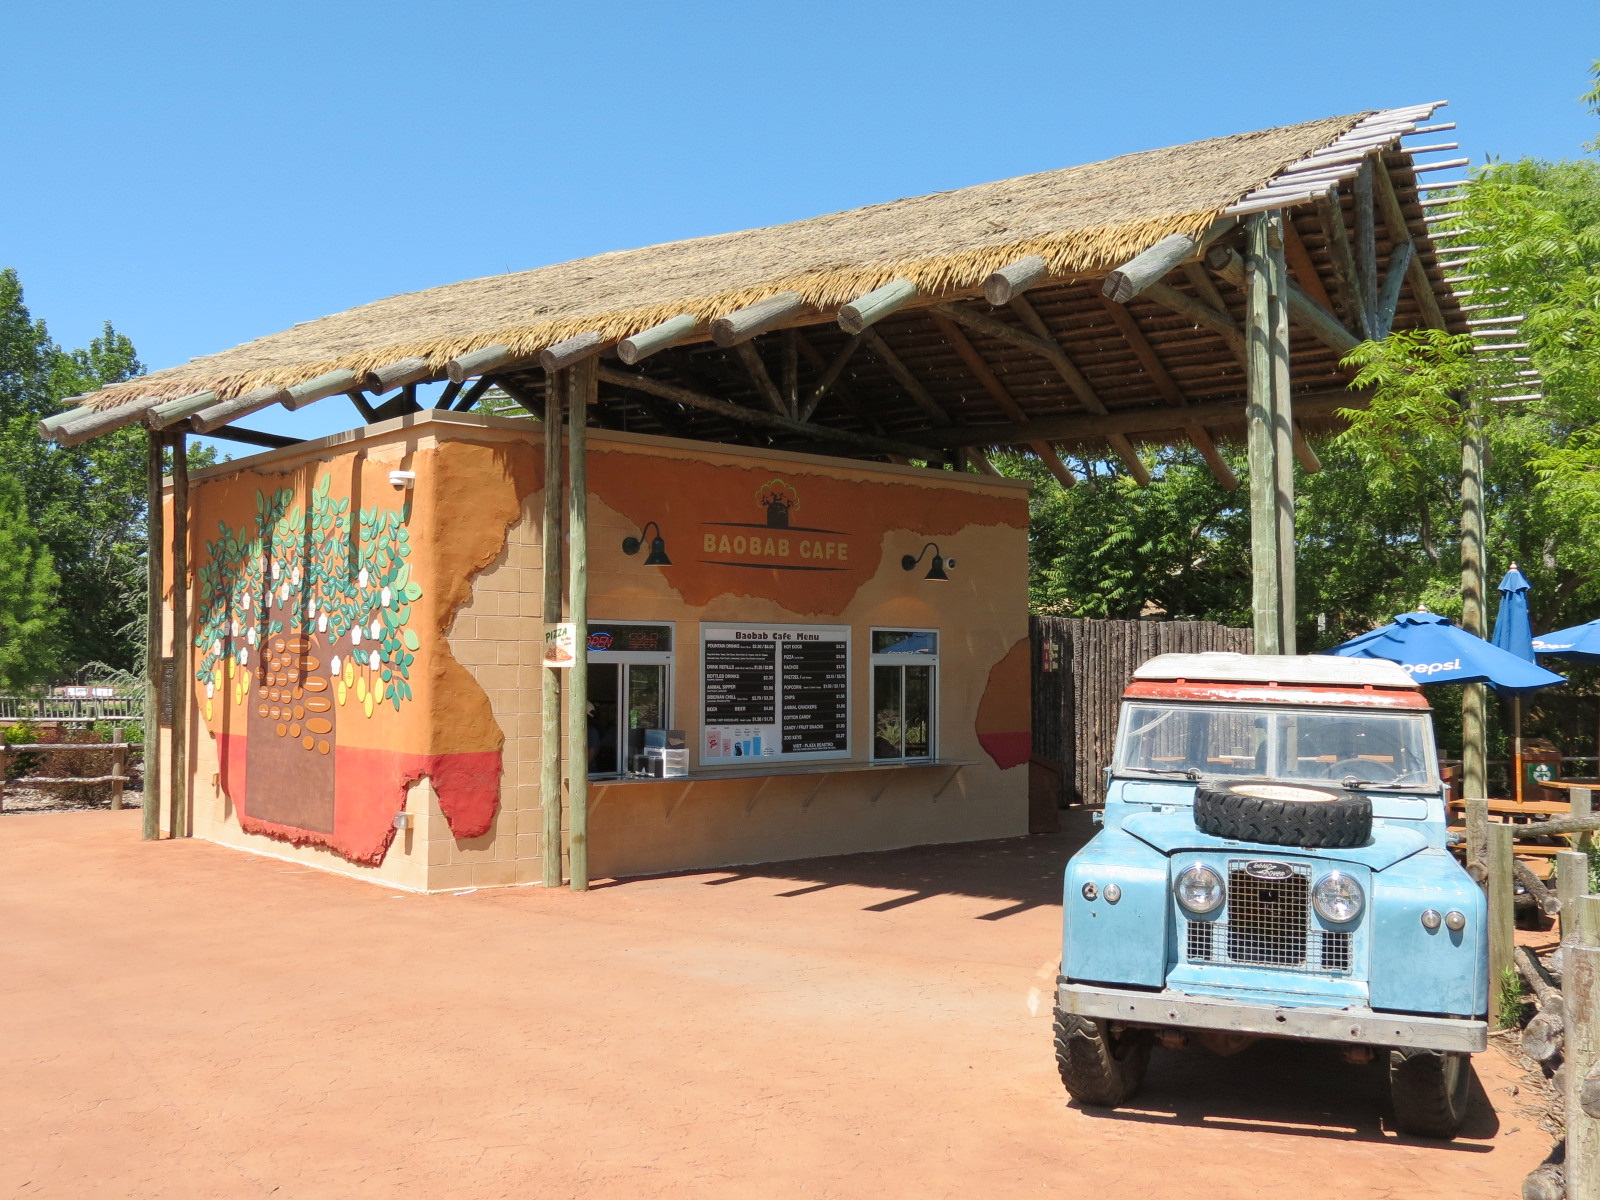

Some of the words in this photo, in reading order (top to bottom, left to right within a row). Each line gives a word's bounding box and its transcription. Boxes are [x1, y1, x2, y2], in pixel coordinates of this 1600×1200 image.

[703, 533, 790, 557] BAOBAB
[800, 540, 848, 561] CAFE
[545, 627, 568, 643] PIZZA
[628, 632, 659, 640] COLD
[735, 631, 768, 640] Baobab
[772, 632, 792, 640] Cafe
[796, 632, 820, 641] Menu
[628, 640, 658, 648] BEER
[1402, 658, 1461, 676] pepsi
